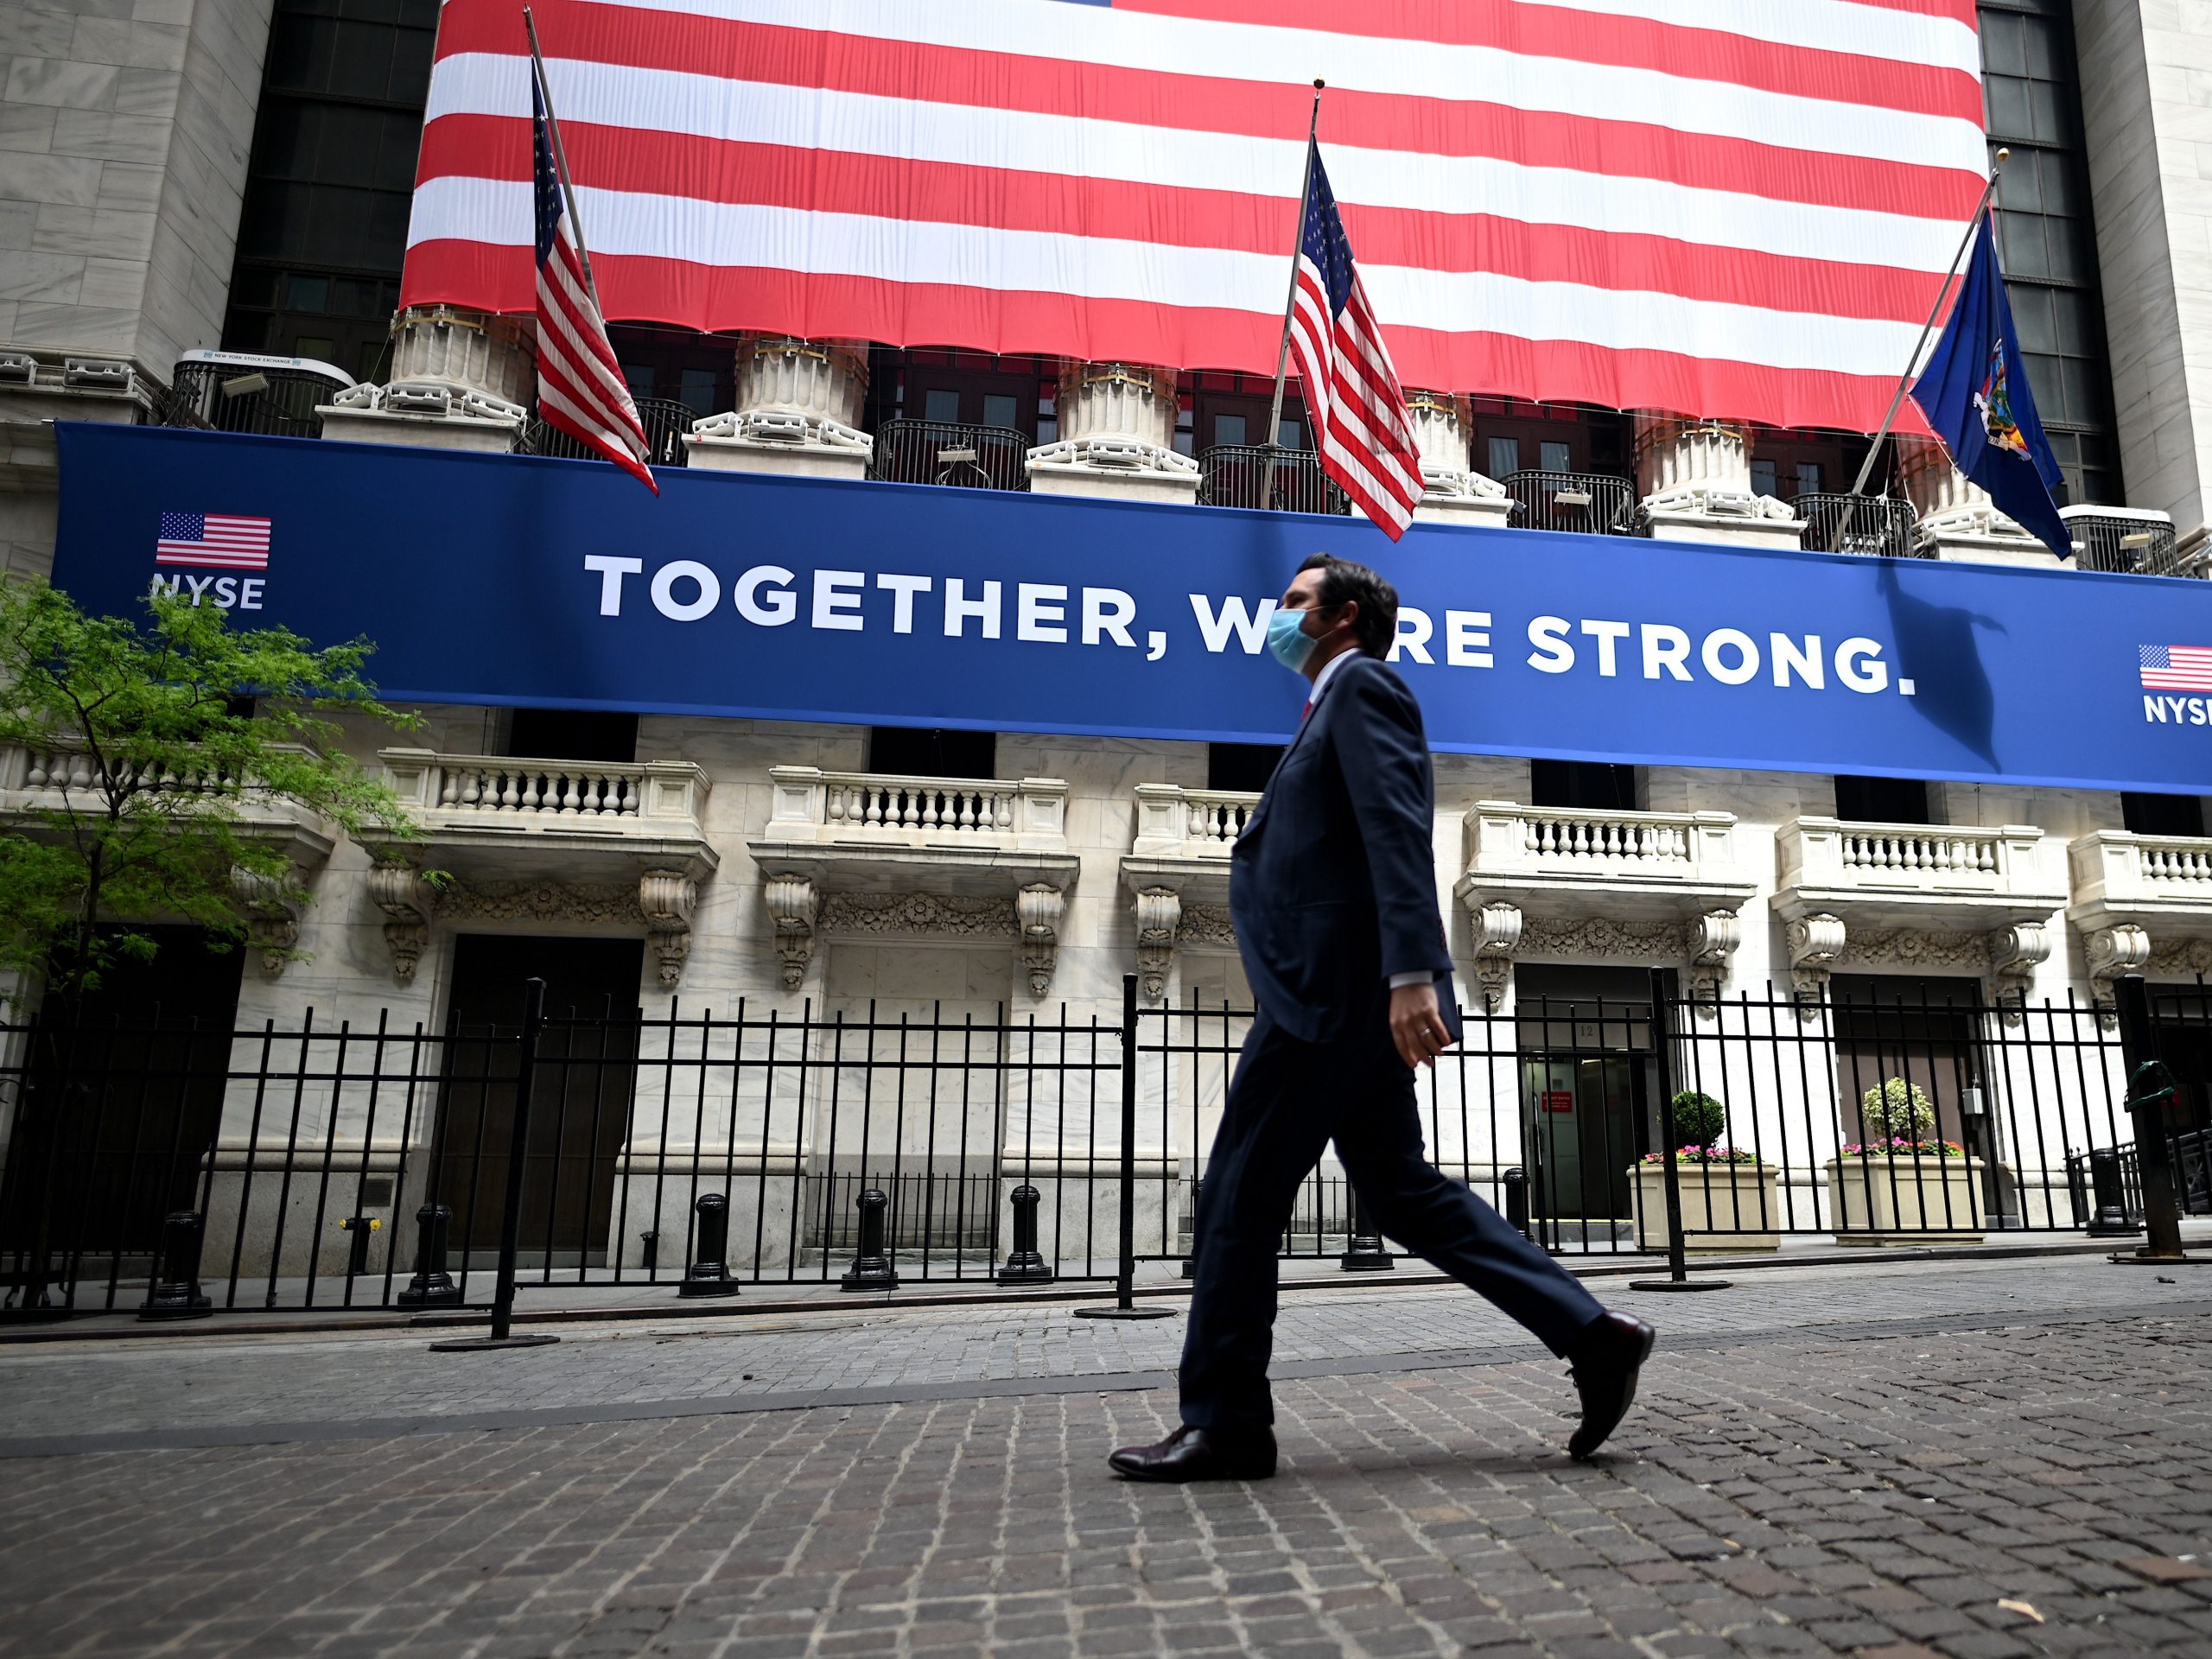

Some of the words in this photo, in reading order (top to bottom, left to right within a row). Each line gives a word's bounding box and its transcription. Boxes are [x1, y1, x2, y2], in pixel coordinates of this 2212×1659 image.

[149, 573, 266, 610] NYSE
[584, 554, 1167, 662] TOGETHER,
[1188, 593, 1494, 668] WRE
[1526, 615, 1916, 696] STRONG.
[1581, 1025, 1593, 1037] 12
